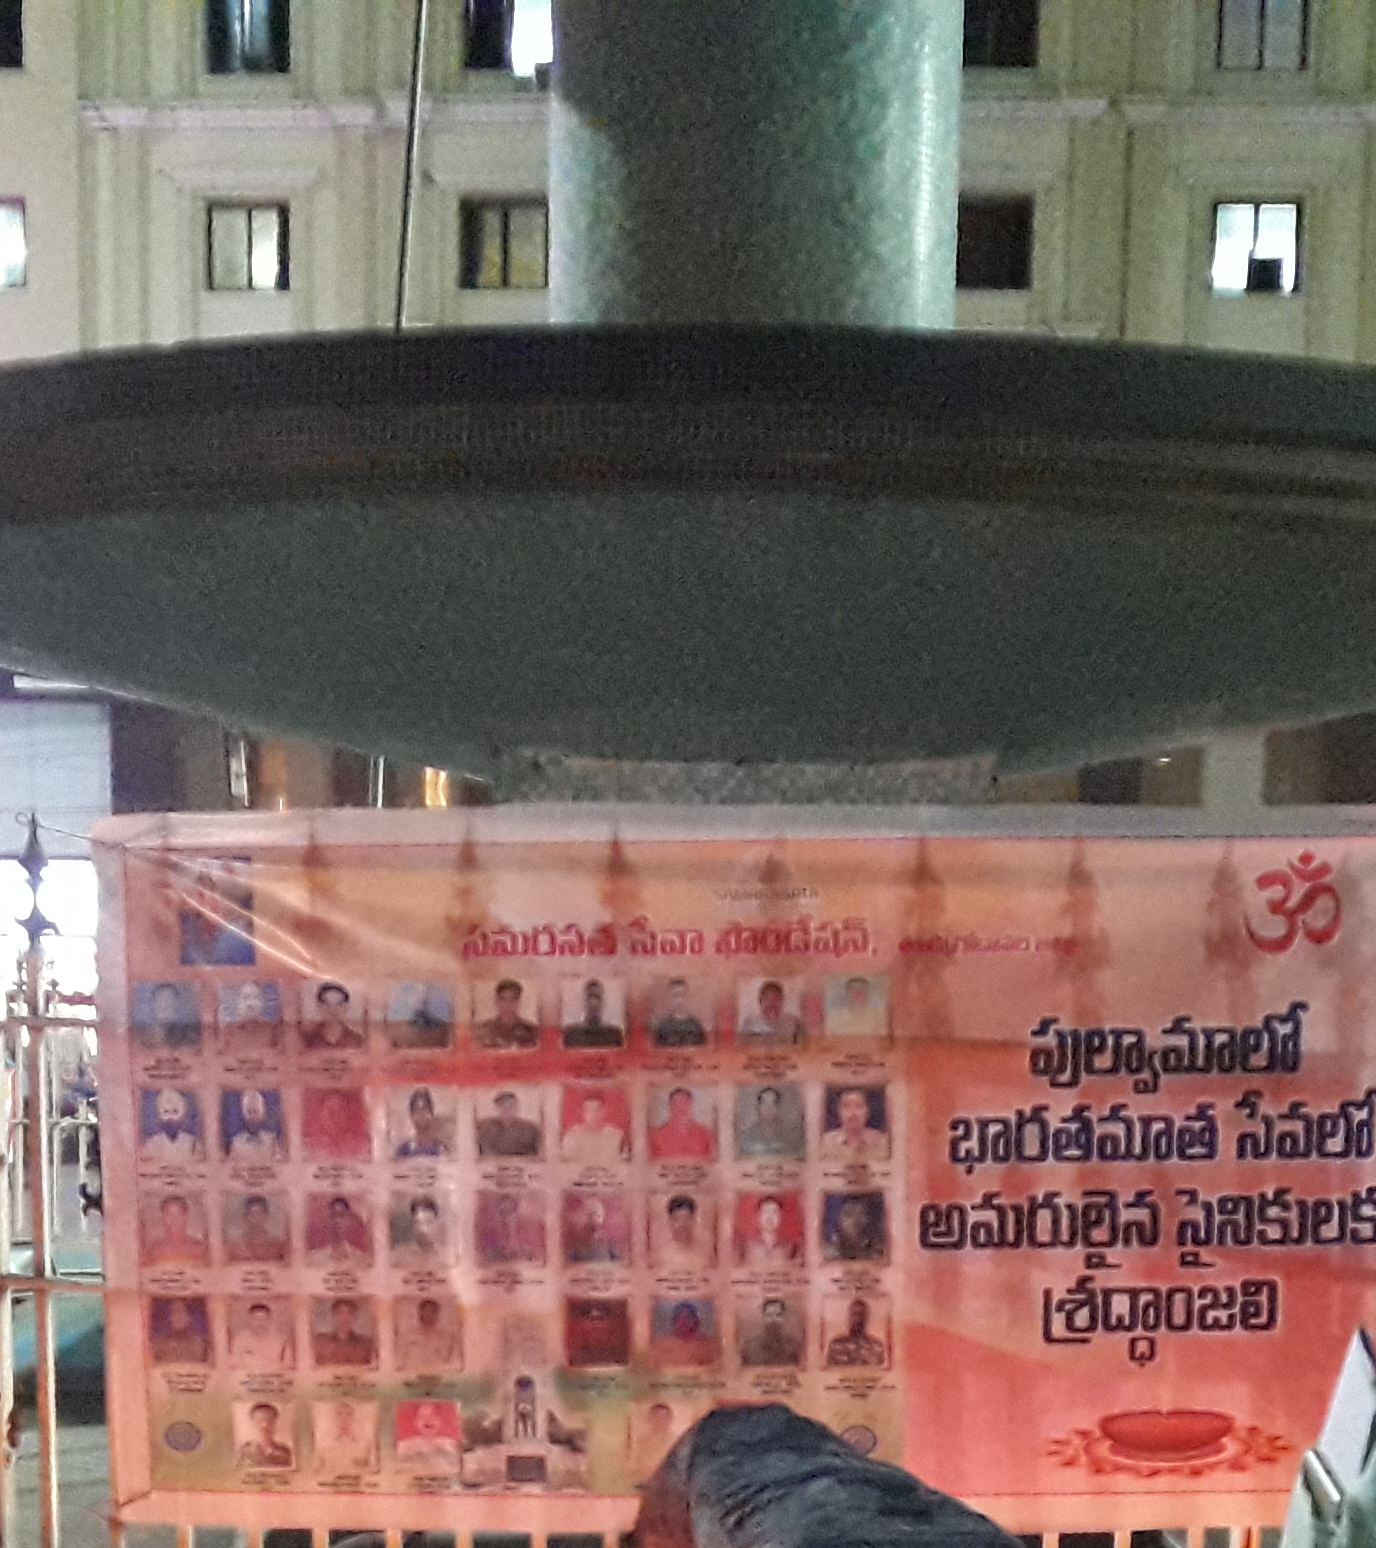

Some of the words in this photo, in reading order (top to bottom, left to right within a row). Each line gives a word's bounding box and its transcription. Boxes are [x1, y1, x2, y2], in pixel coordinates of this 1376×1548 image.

[1028, 1001, 1309, 1094] పుల్వామాలో
[949, 1101, 1220, 1175] భారతమాత
[919, 1187, 1163, 1270] అమరులైన
[1041, 1276, 1279, 1366] శ్రద్ధాంజలి
